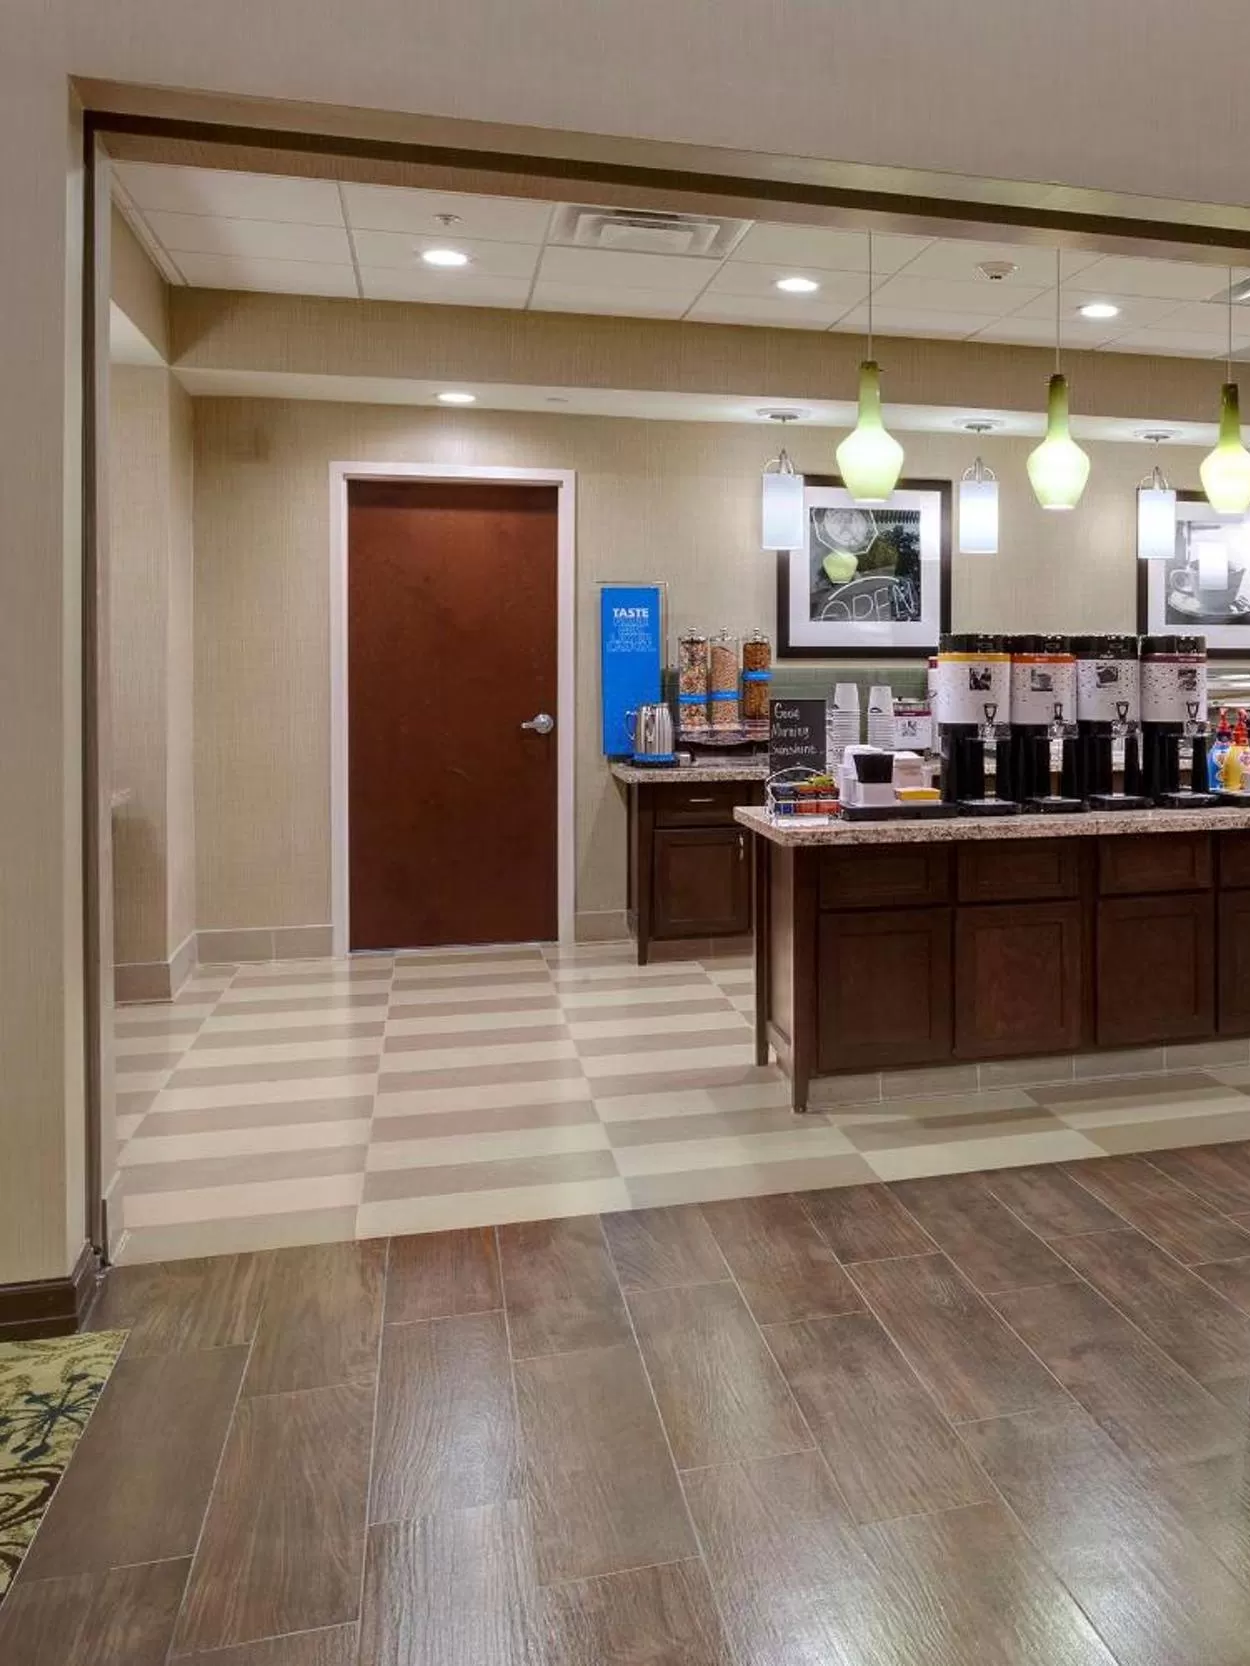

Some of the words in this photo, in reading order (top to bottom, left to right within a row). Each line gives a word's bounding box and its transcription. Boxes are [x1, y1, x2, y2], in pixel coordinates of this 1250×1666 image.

[821, 580, 916, 621] OPEN
[612, 608, 650, 617] TASTE
[774, 702, 801, 721] Good
